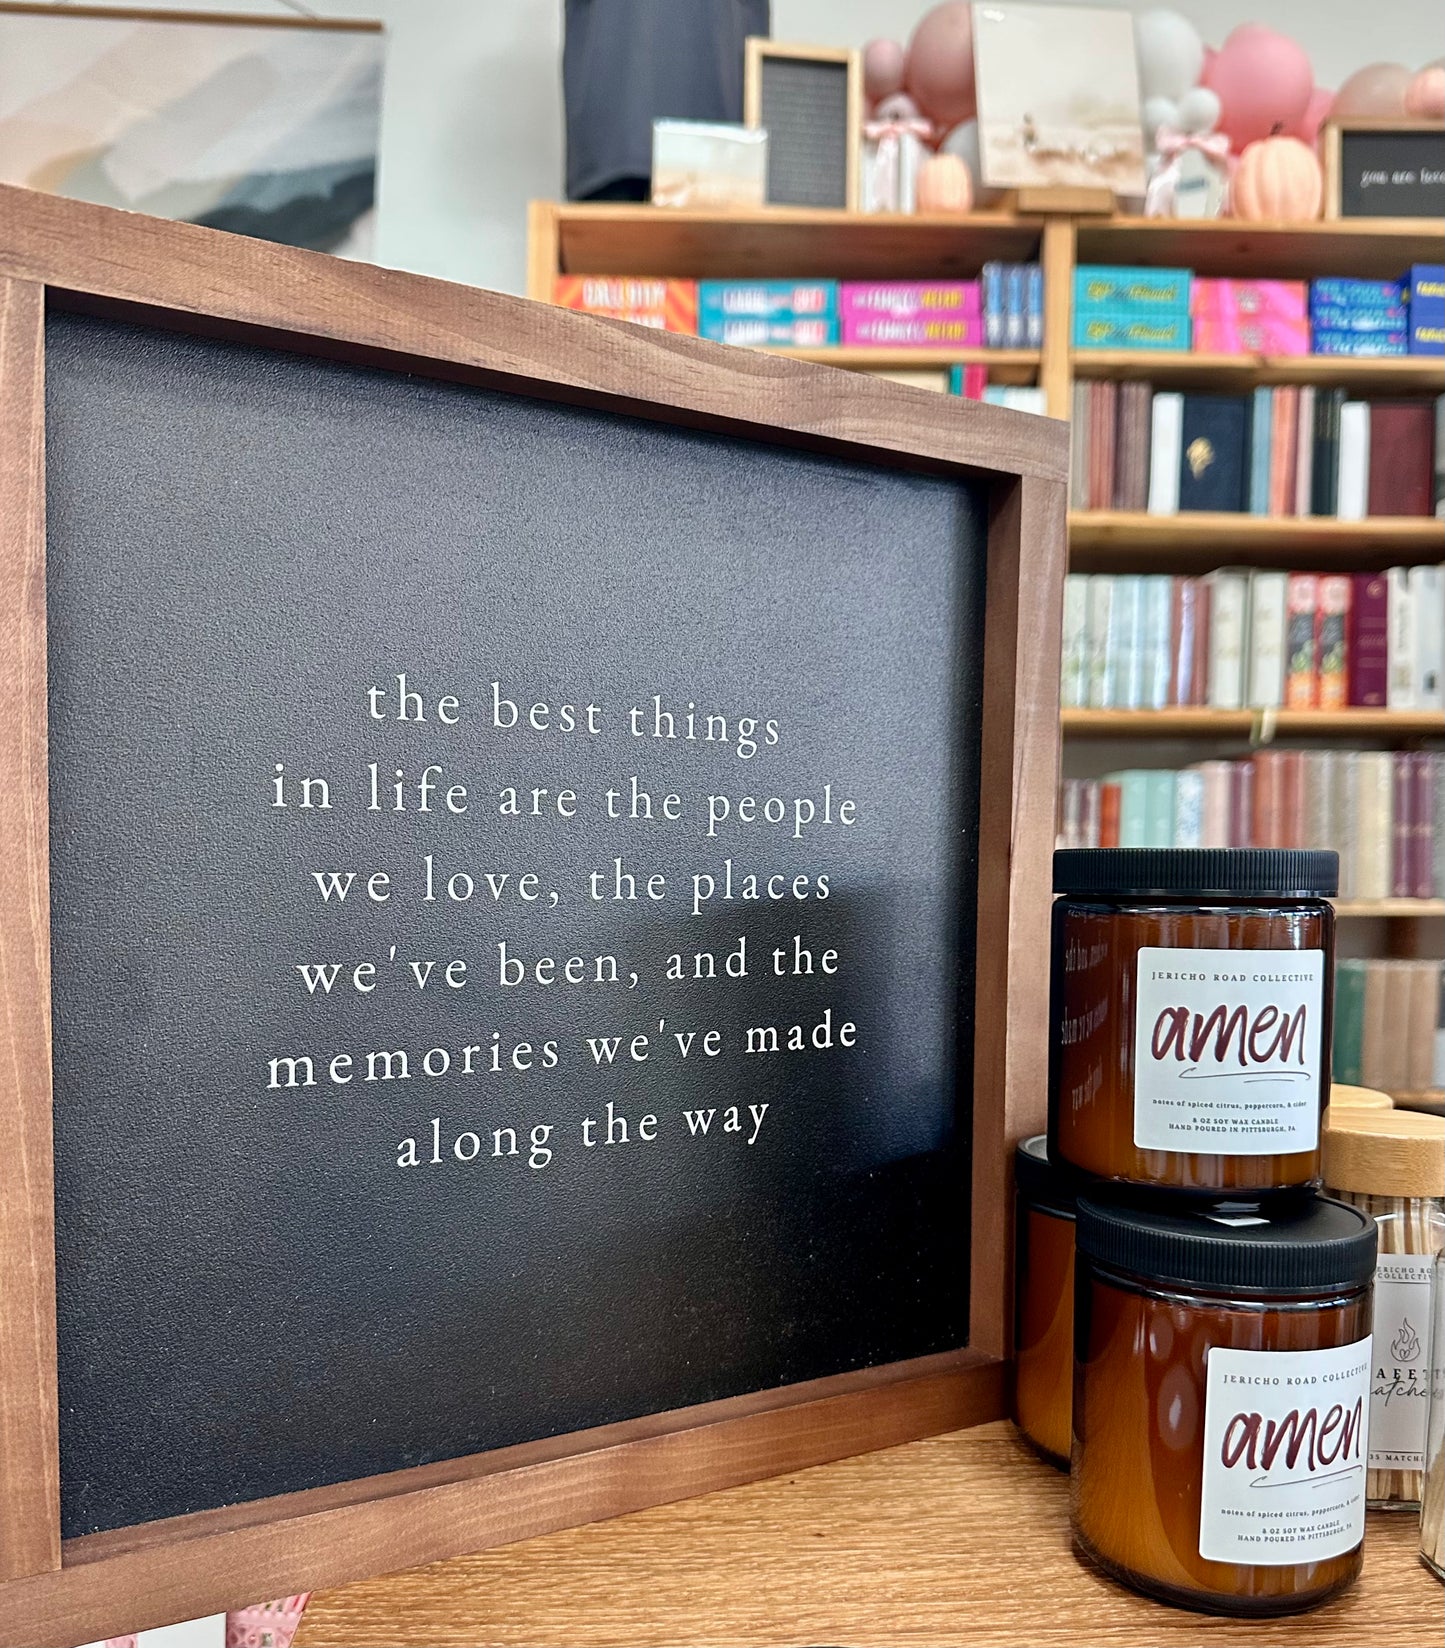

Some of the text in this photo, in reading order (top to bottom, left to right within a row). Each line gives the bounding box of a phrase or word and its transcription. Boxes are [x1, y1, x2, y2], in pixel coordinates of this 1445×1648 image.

[366, 672, 780, 760] the best things
[271, 762, 858, 839] in life are the people
[310, 854, 830, 916] we love, the places
[295, 934, 839, 995] we've been, and the
[1151, 971, 1314, 982] JERICHO ROAD COLLECTIVE
[1151, 1003, 1307, 1067] amen
[266, 1008, 857, 1089] memories we've made
[1152, 1098, 1174, 1106] notes
[1187, 1100, 1213, 1109] spiced
[1168, 1123, 1192, 1131] HAND
[1195, 1125, 1227, 1133] POURED
[1200, 1117, 1211, 1125] OZ
[396, 1101, 770, 1169] along the way
[1377, 1266, 1414, 1274] ERICHO
[1223, 1362, 1368, 1386] JERICHO ROAD COLLECTIVE
[1221, 1396, 1363, 1472] amen
[1221, 1508, 1244, 1516] notes
[1246, 1509, 1255, 1517] of
[1257, 1510, 1283, 1519] spiced
[1237, 1534, 1261, 1542] HAND
[1283, 1526, 1297, 1534] SOY
[1299, 1524, 1315, 1533] WAX
